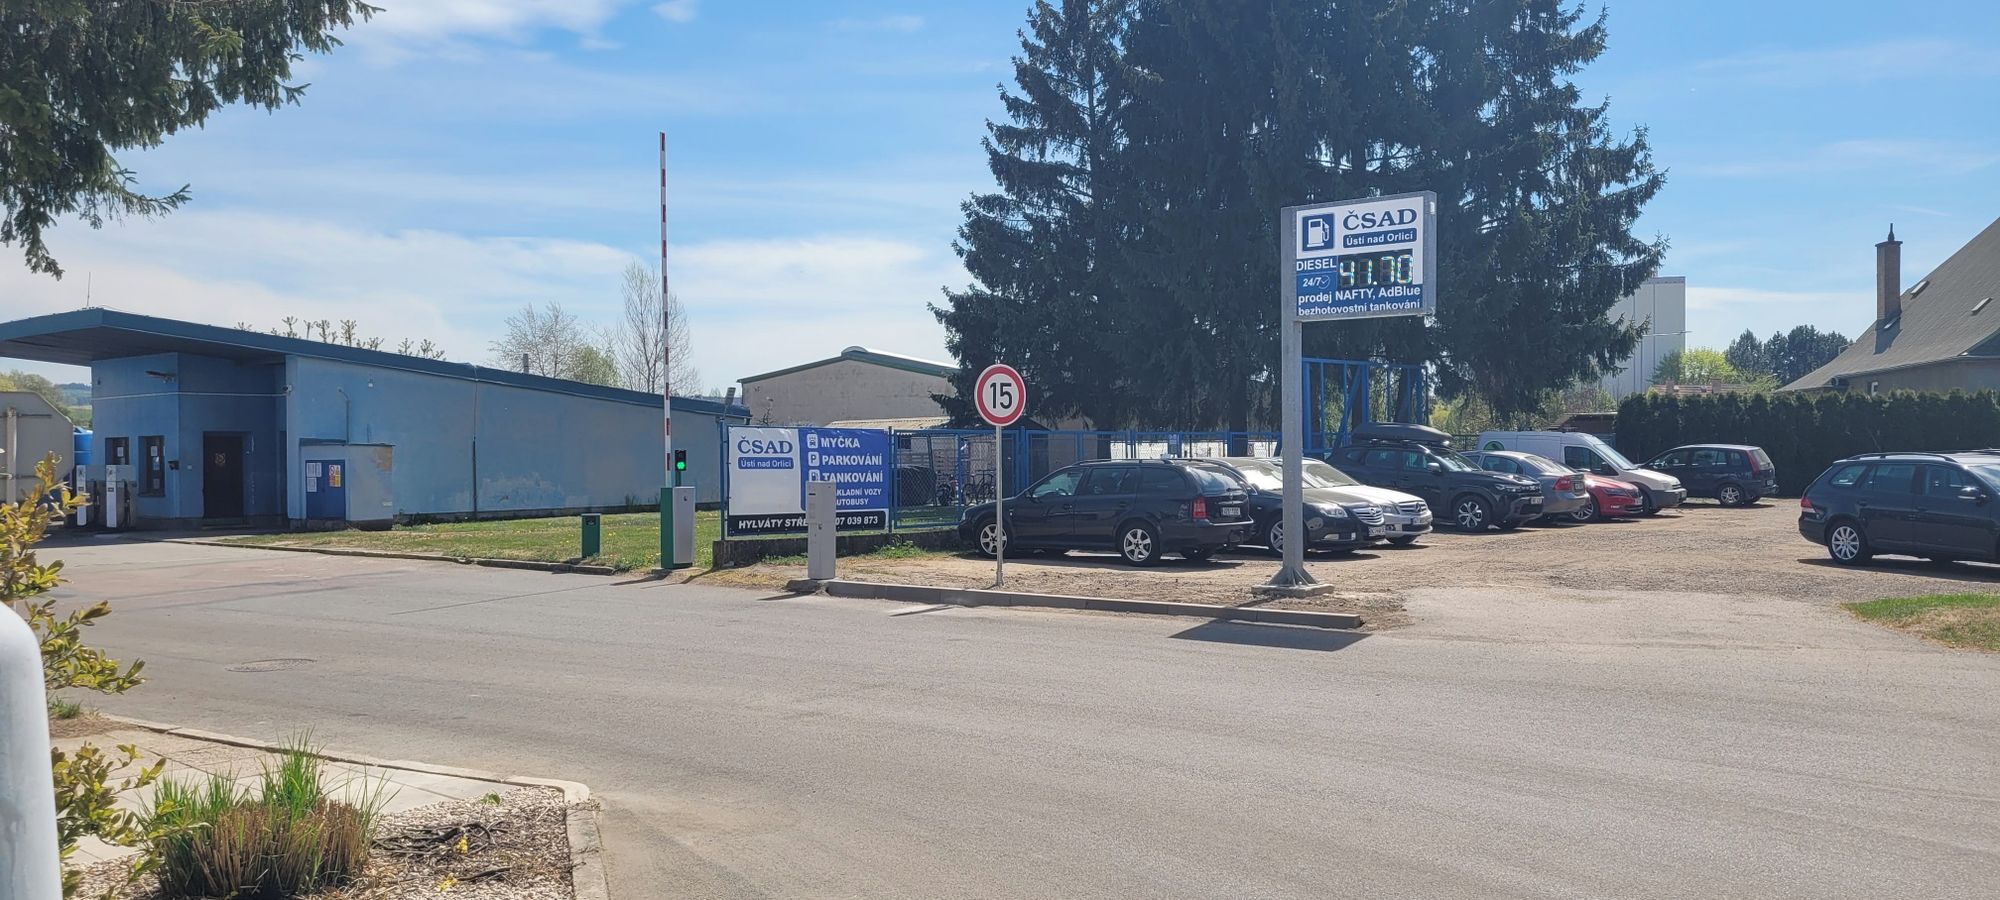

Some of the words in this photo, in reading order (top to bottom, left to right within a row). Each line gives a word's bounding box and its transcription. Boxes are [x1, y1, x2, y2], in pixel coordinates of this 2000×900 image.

[1343, 208, 1417, 231] ČSAD
[1346, 235, 1365, 246] Ústí
[1367, 232, 1384, 244] nad
[1387, 230, 1413, 242] Orlicí
[1296, 258, 1337, 271] DIESEL
[1339, 254, 1414, 286] 41.70
[1302, 277, 1321, 287] 24/7
[1298, 291, 1332, 305] prodej
[1335, 287, 1376, 301] NAFTY,
[1378, 285, 1421, 298] AdBlue
[1298, 302, 1367, 316] bezhotovostní
[1369, 299, 1420, 312] tankování
[989, 382, 1013, 410] 15
[737, 436, 793, 455] ČSAD
[820, 436, 861, 448] MYČKA
[741, 459, 757, 468] Ústí
[757, 460, 771, 468] nad
[771, 459, 792, 468] Orlicí
[822, 453, 883, 466] PARKOVÁNÍ
[822, 470, 883, 483] TANKOVÁNÍ
[836, 487, 863, 496] KLADNÍ
[863, 488, 882, 496] VOZY
[836, 498, 869, 506] UTOBUSY
[738, 517, 783, 530] HYLVÁTY
[785, 517, 808, 527] STŘE
[835, 517, 846, 526] 07
[846, 516, 862, 525] 039
[863, 515, 879, 525] 873
